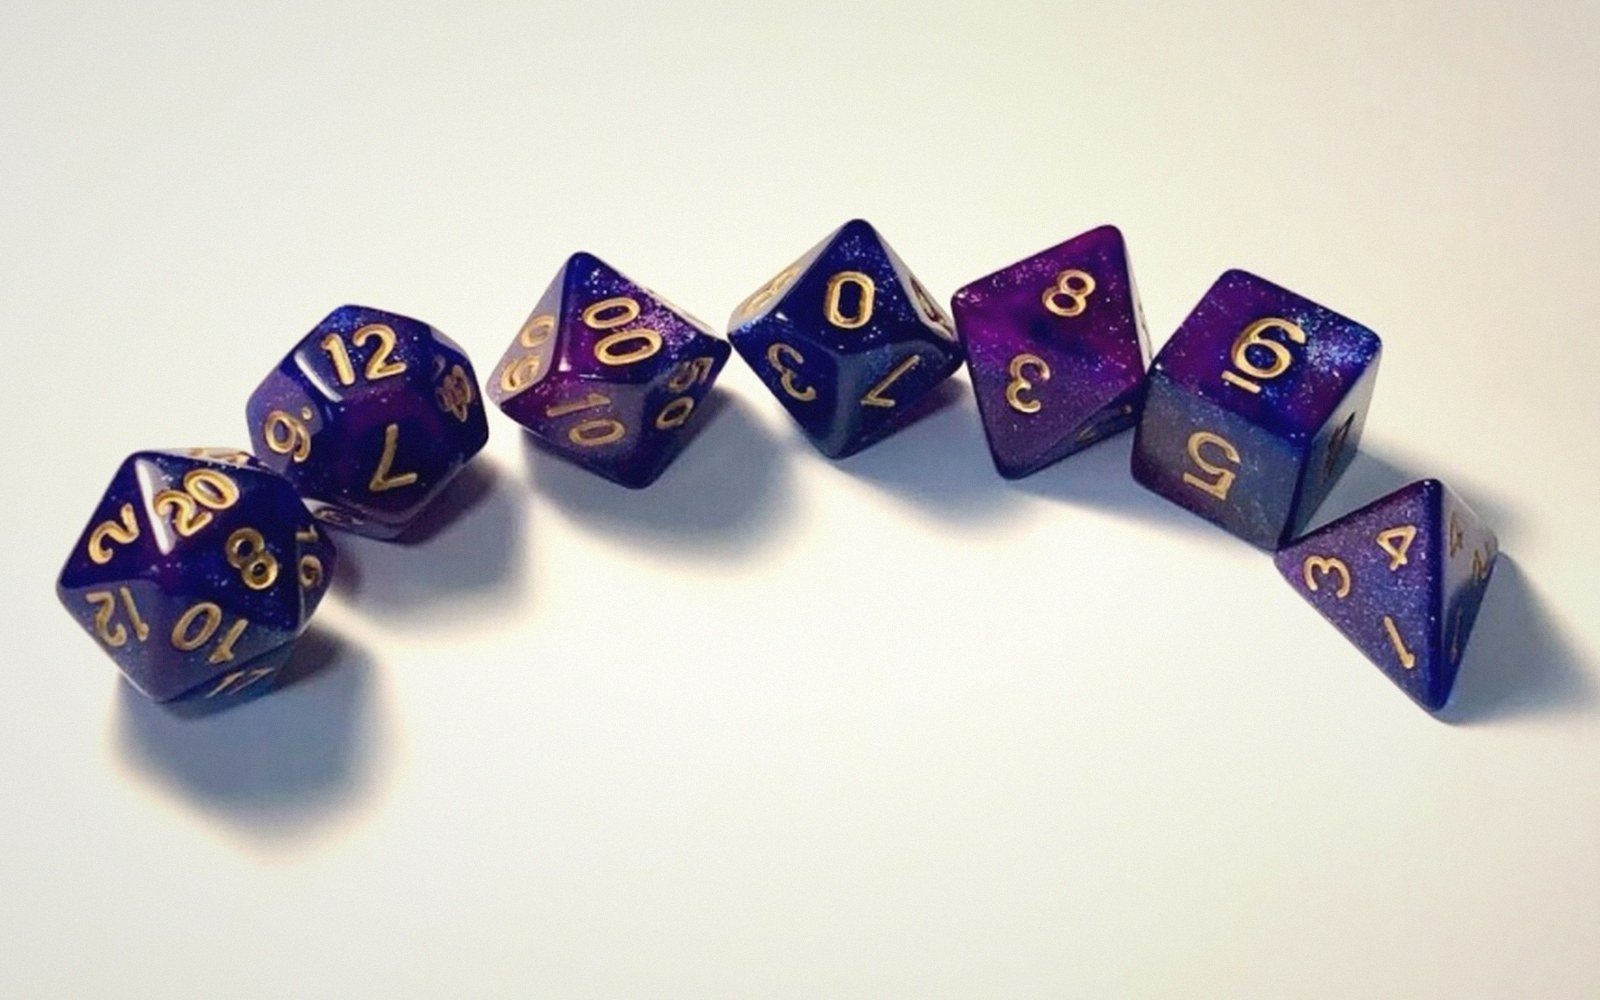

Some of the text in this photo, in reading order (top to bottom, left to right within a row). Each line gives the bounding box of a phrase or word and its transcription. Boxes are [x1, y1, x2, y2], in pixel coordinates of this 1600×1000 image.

[824, 270, 875, 329] 0
[1042, 268, 1096, 317] 8
[321, 323, 407, 386] 12
[582, 296, 663, 366] 00
[767, 342, 816, 402] 3
[860, 354, 920, 408] 7
[1006, 353, 1050, 414] 3
[546, 393, 625, 447] 10
[369, 423, 418, 492] 7
[1183, 431, 1242, 501] 5
[153, 468, 240, 537] 20
[87, 502, 140, 565] 2
[225, 527, 278, 590] 8
[1376, 525, 1417, 571] 4
[1304, 555, 1350, 598] 3
[86, 587, 149, 647] 12
[172, 602, 248, 664] 10
[1383, 615, 1416, 669] 1
